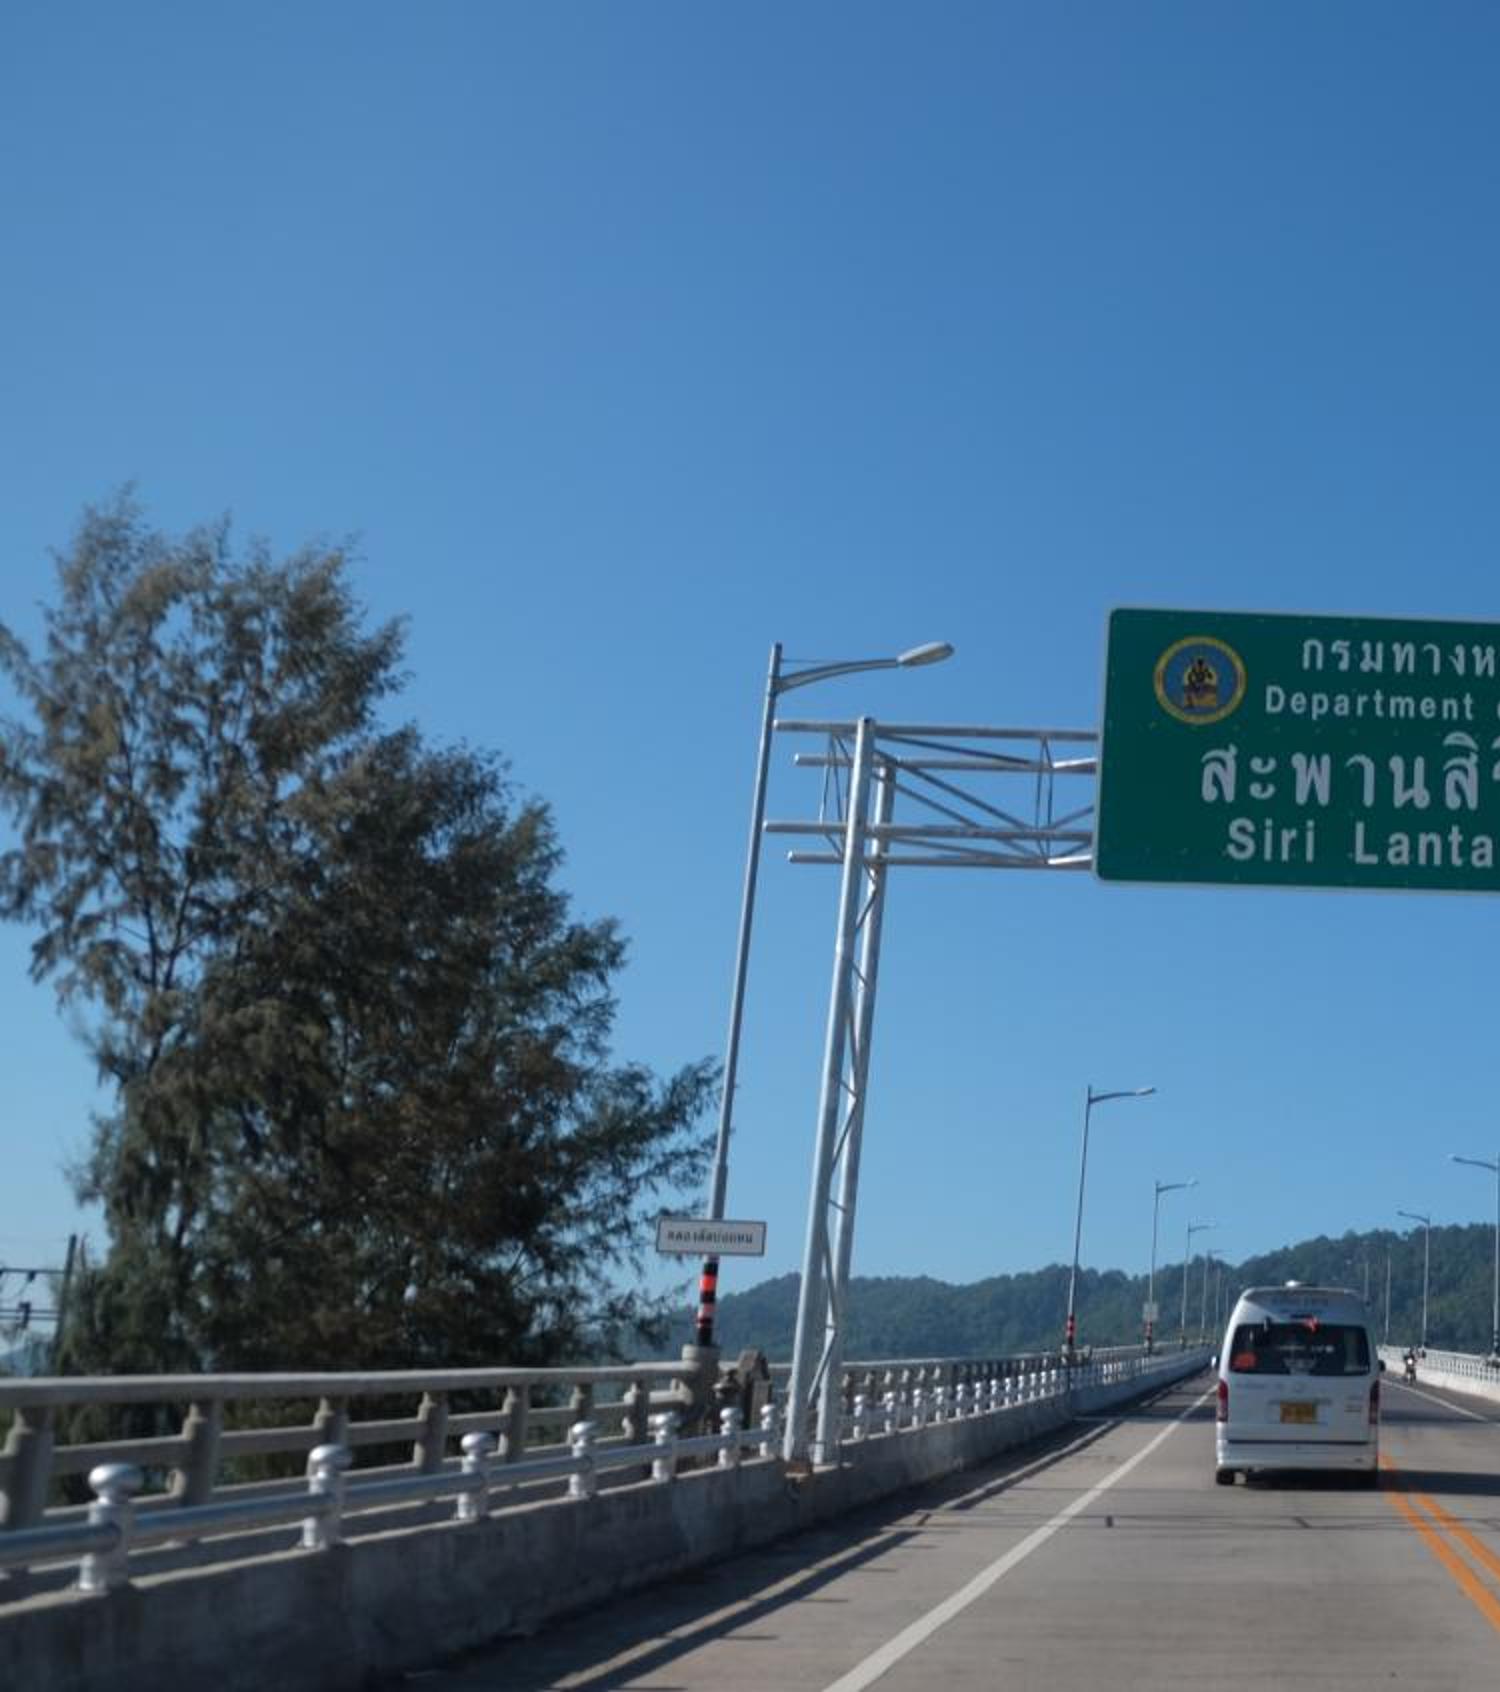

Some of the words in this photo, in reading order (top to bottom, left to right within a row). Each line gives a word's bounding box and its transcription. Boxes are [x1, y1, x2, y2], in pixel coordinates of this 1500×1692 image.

[1265, 686, 1475, 721] Department
[1227, 818, 1315, 864] Siri
[1355, 822, 1494, 869] Lanta
